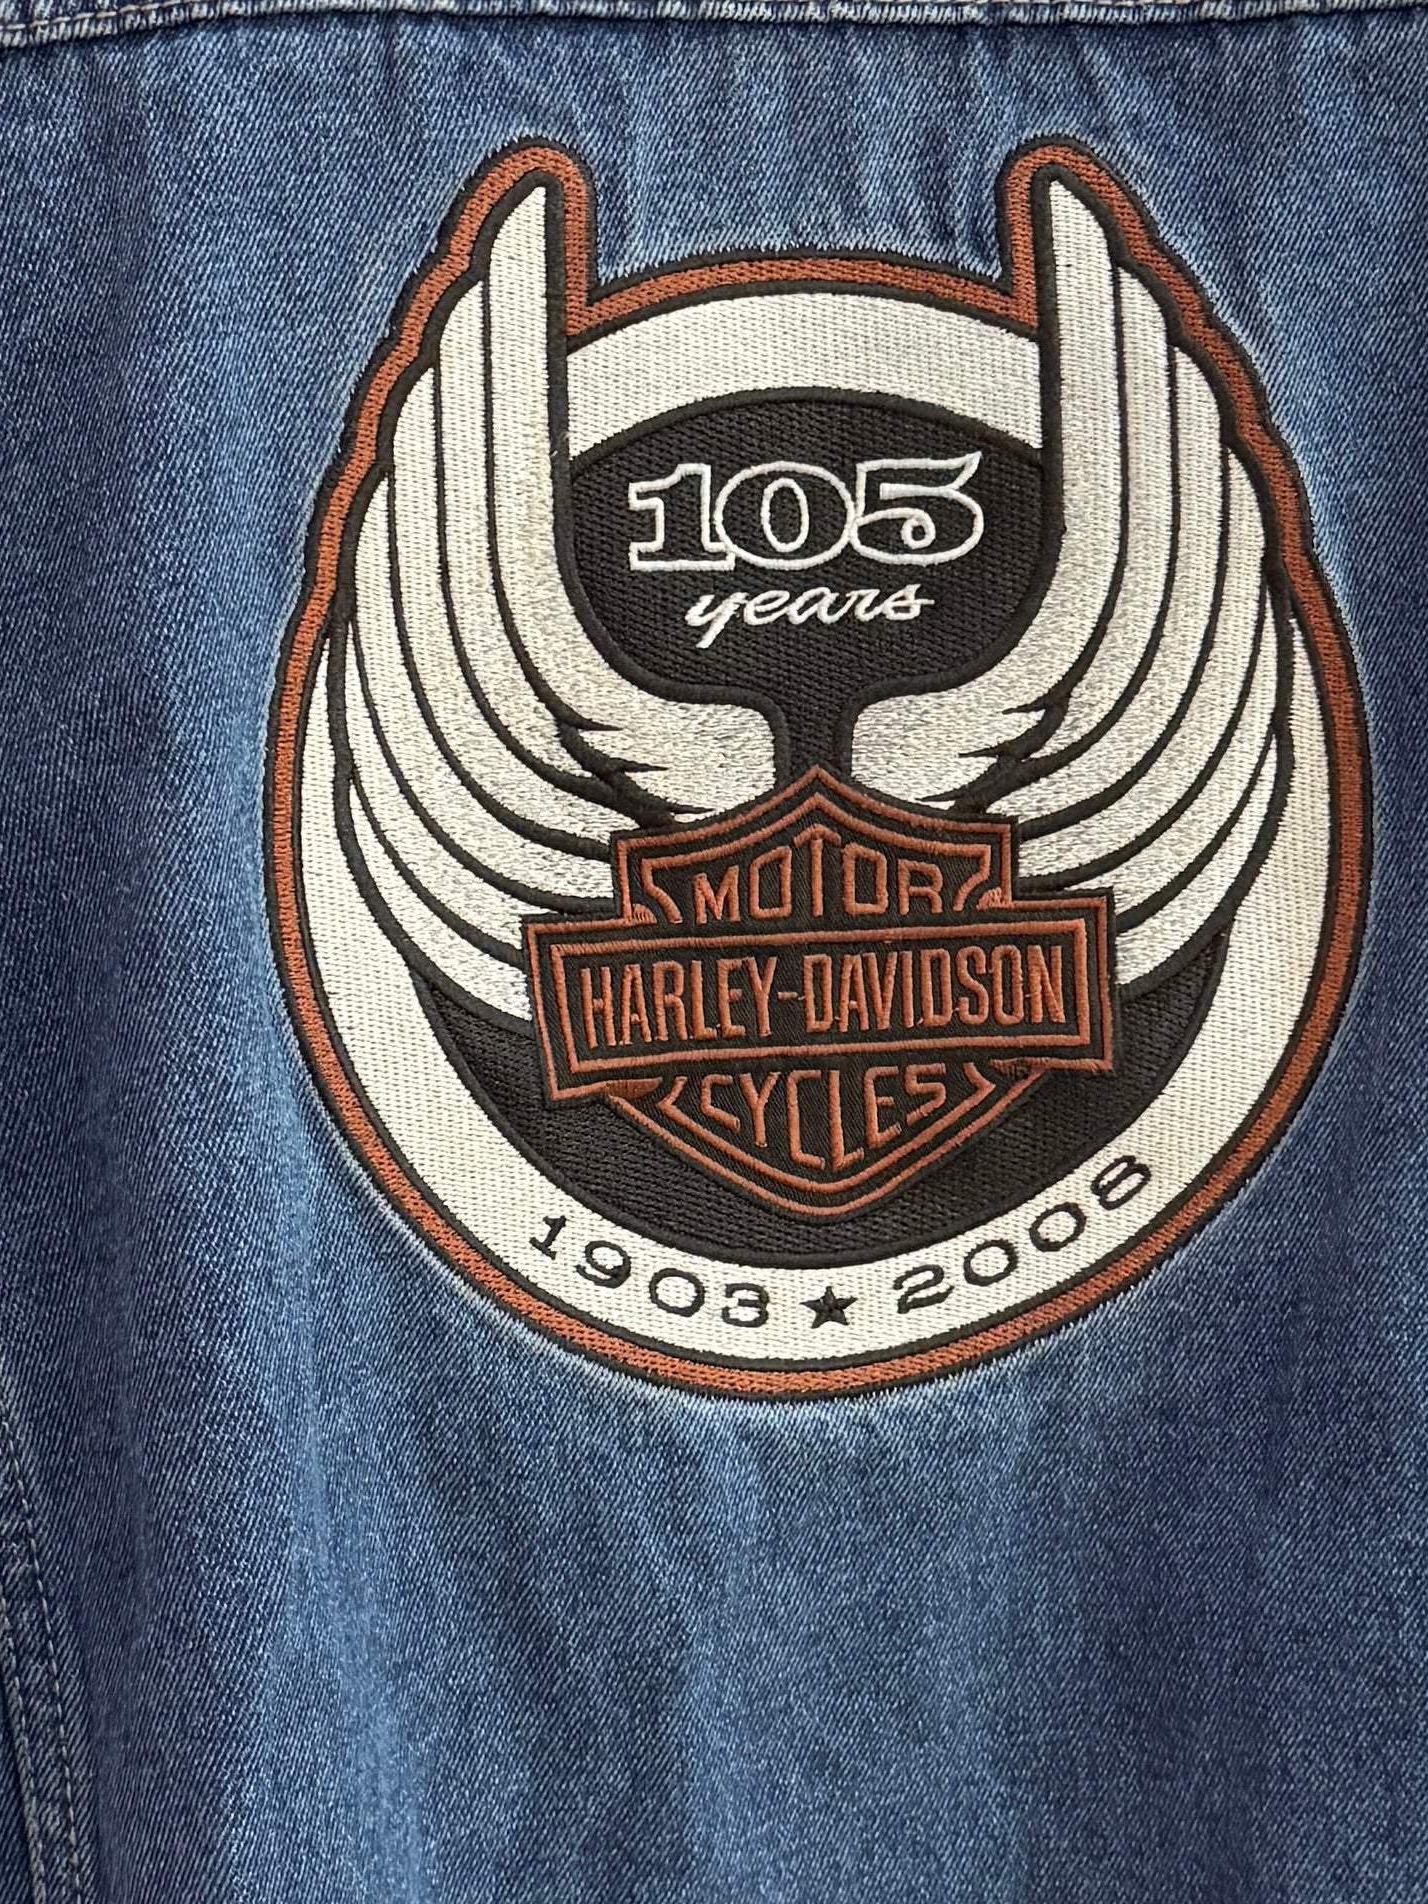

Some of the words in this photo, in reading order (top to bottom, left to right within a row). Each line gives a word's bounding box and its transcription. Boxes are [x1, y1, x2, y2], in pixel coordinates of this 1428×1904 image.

[628, 451, 984, 570] 105
[685, 584, 935, 649] years
[693, 824, 943, 924] MOTOR
[580, 945, 1066, 1049] HARLEY-DAVIDSON
[701, 1062, 946, 1171] CYCLES
[529, 1214, 770, 1327] 1903
[894, 1154, 1152, 1314] 2008
